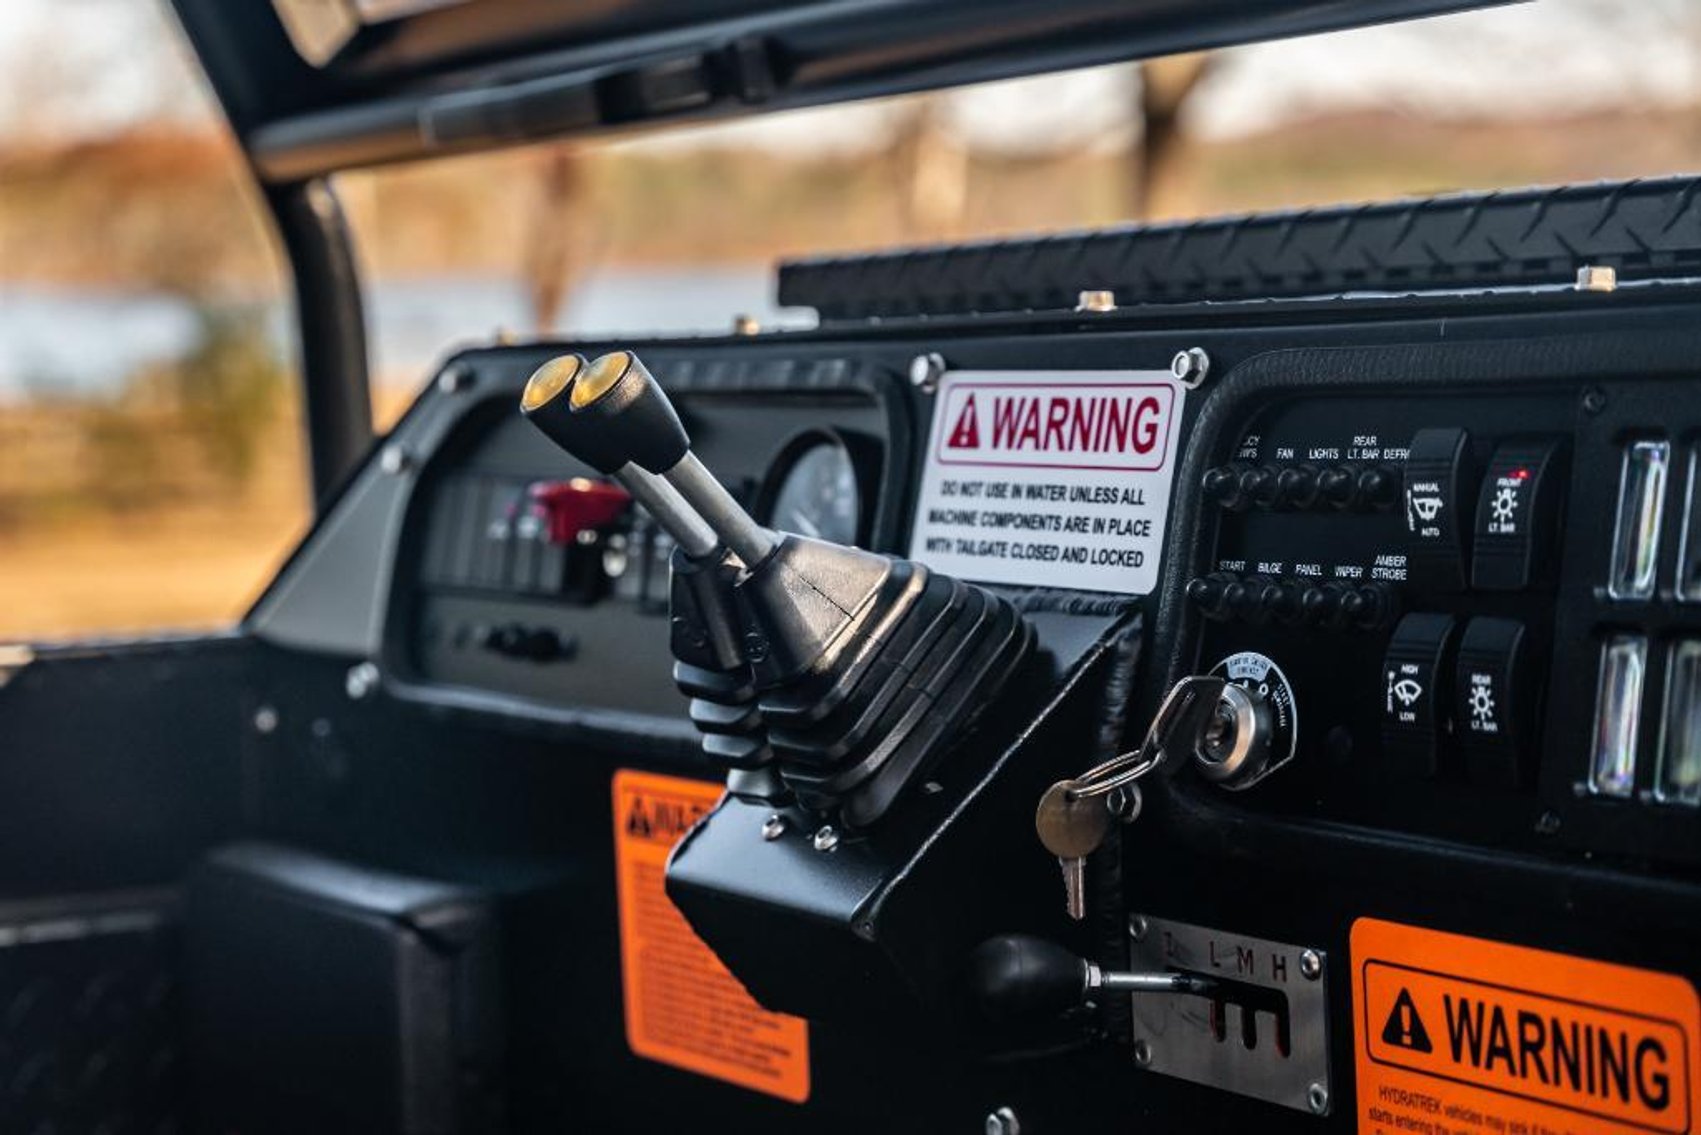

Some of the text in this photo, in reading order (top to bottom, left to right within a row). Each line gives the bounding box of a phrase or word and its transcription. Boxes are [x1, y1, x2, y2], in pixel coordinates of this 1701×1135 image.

[991, 396, 1160, 454] WARNING
[1353, 436, 1377, 446] REAR
[1276, 448, 1294, 459] FAN
[1309, 448, 1339, 459] LIGHTS
[1361, 448, 1380, 459] BAR
[941, 481, 1144, 506] DO NOT USE IN WATER UNLESS ALL
[929, 509, 1151, 536] MACHINE COMPONENTS ARE IN PLACE
[926, 537, 1144, 567] WITH TAILGATE CLOSED AND LOCKED
[1219, 560, 1246, 571] START
[1375, 555, 1407, 567] AMBER
[1257, 562, 1282, 574] BILGE
[1295, 564, 1322, 576] PANEL
[1371, 568, 1407, 581] STROBE
[1210, 941, 1220, 967] L
[1237, 946, 1253, 974] M
[1272, 954, 1287, 982] H
[1443, 994, 1670, 1111] WARNING
[1379, 1085, 1441, 1114] HYDRATREK
[1444, 1105, 1482, 1125] vehicles
[1369, 1107, 1394, 1122] starts
[1395, 1113, 1433, 1135] entering
